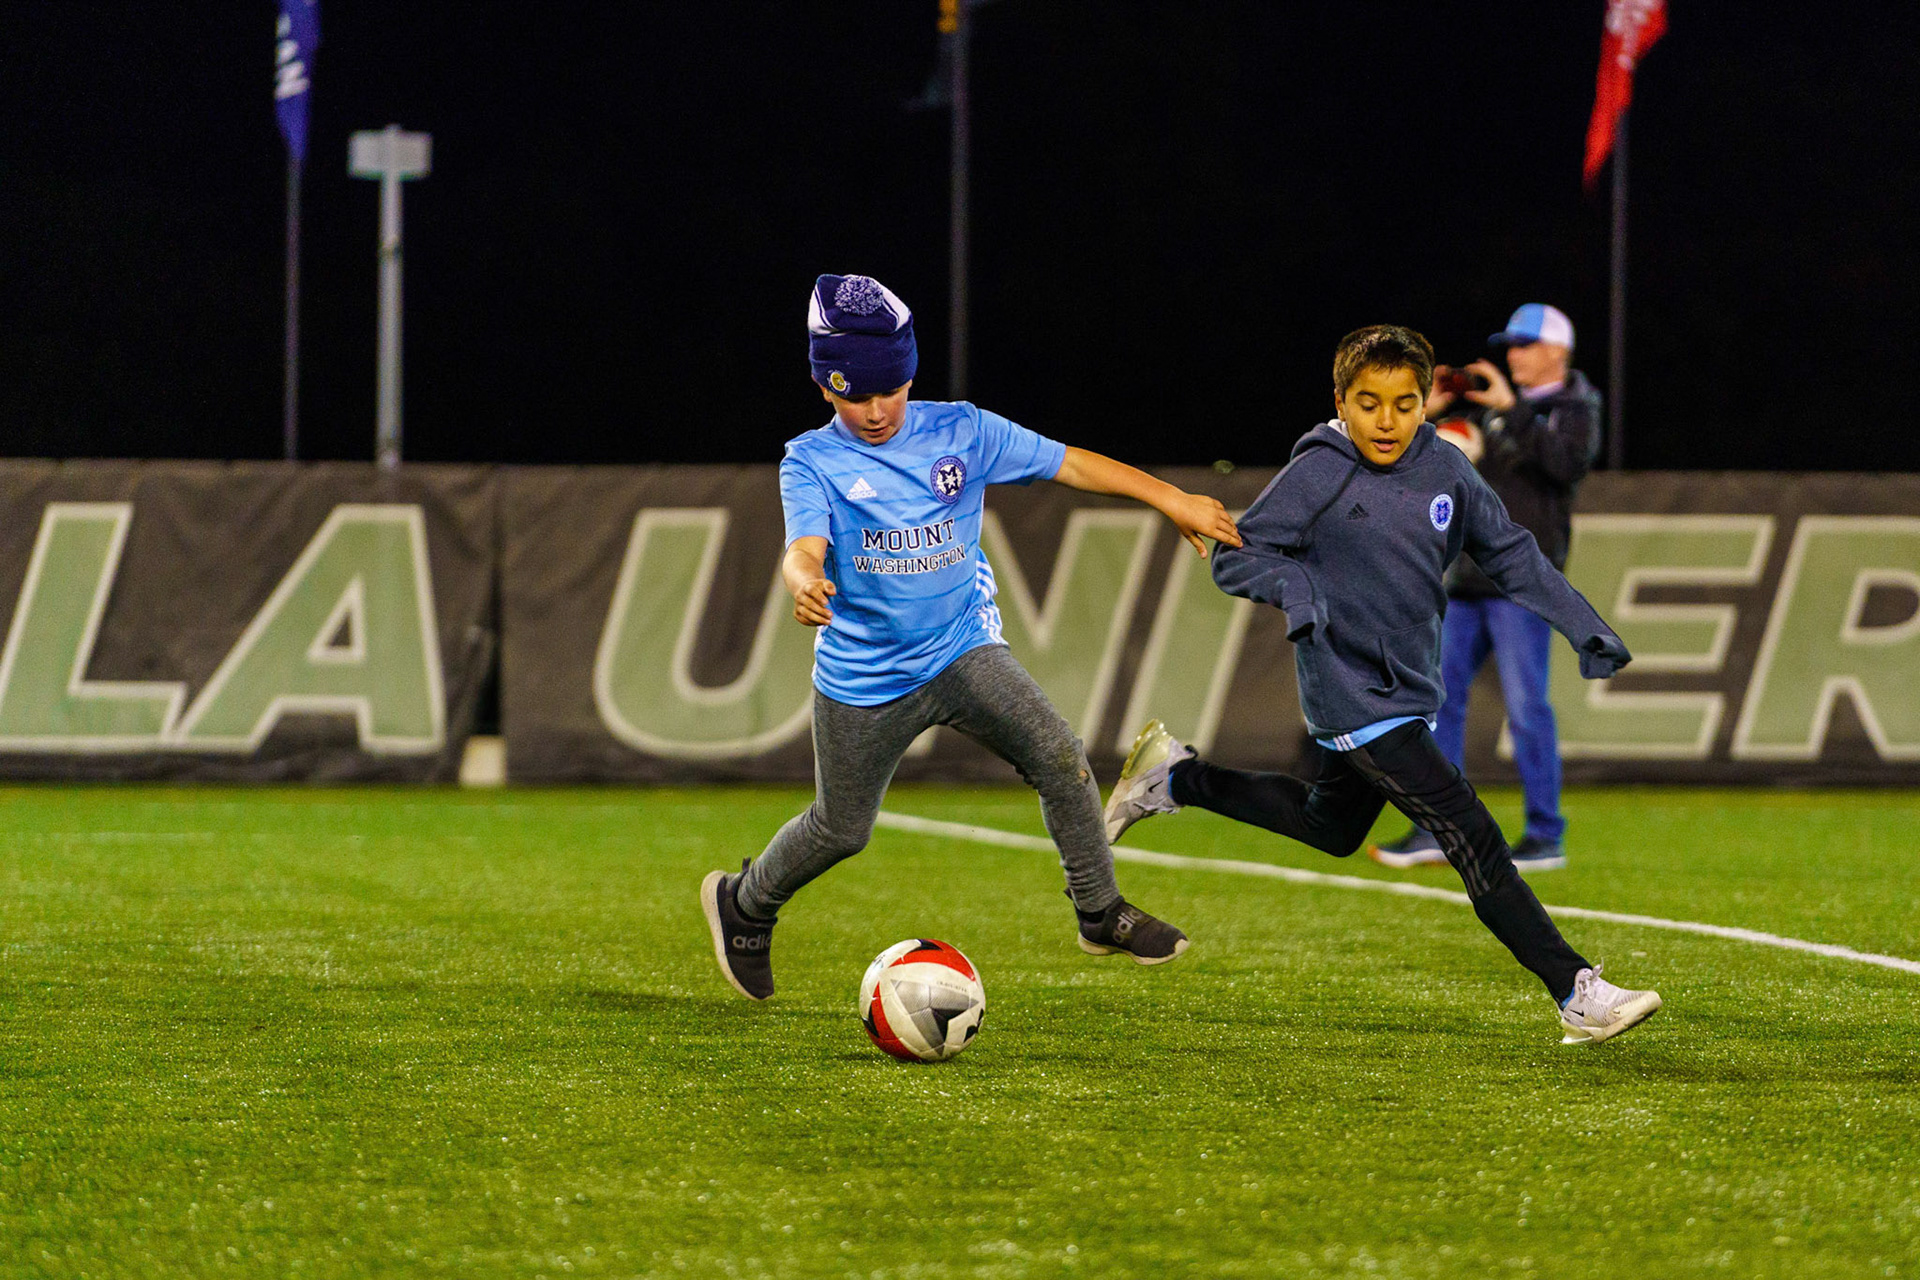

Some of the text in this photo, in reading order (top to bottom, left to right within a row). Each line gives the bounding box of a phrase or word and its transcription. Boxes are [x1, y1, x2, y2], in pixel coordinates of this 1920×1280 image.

[846, 489, 878, 501] adidas
[861, 518, 955, 552] MOUNT
[853, 543, 967, 575] WASHINGTON
[594, 507, 1920, 761] UNIER
